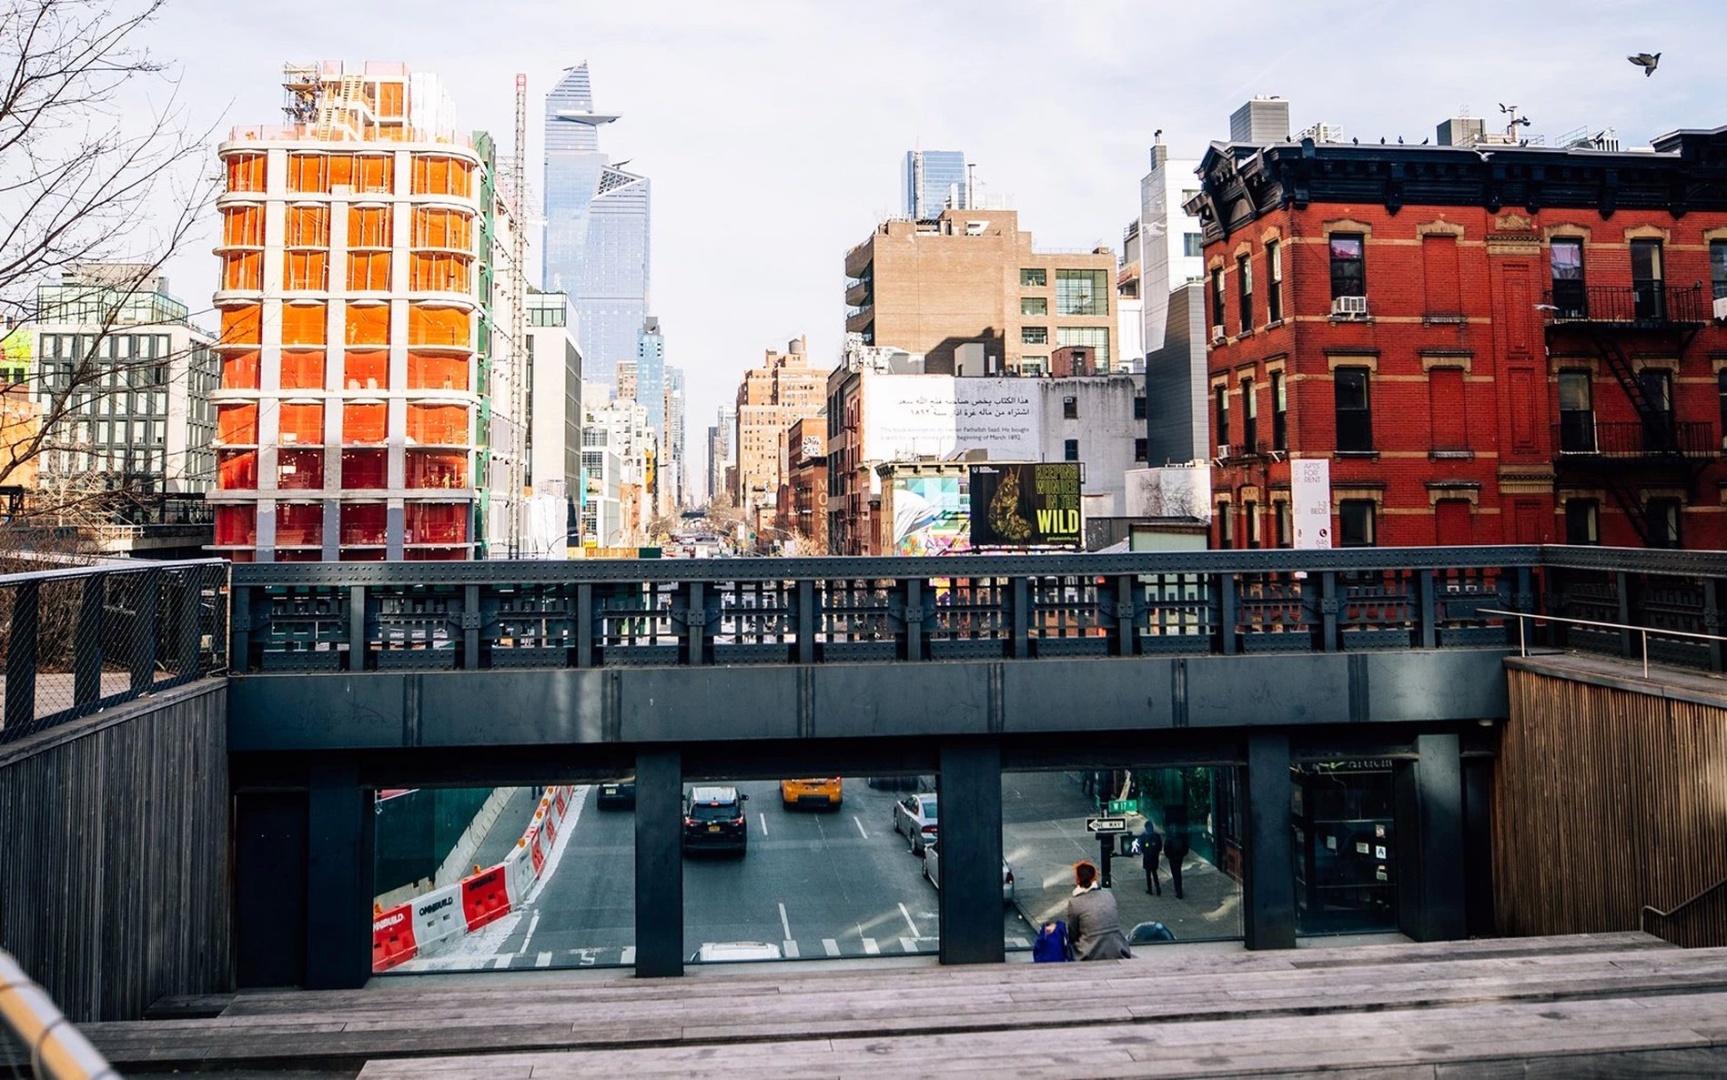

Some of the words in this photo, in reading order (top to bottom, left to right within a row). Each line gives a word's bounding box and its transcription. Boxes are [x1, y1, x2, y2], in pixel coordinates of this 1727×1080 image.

[957, 434, 982, 442] beginning
[1304, 462, 1321, 470] APTS
[1304, 476, 1321, 484] RENT
[1046, 494, 1057, 509] IN
[1060, 494, 1079, 509] THE
[1310, 507, 1328, 515] BEDS
[1036, 509, 1079, 534] WILD
[1120, 802, 1127, 810] 17
[1377, 847, 1384, 856] A
[419, 896, 453, 916] OMNIBUILD
